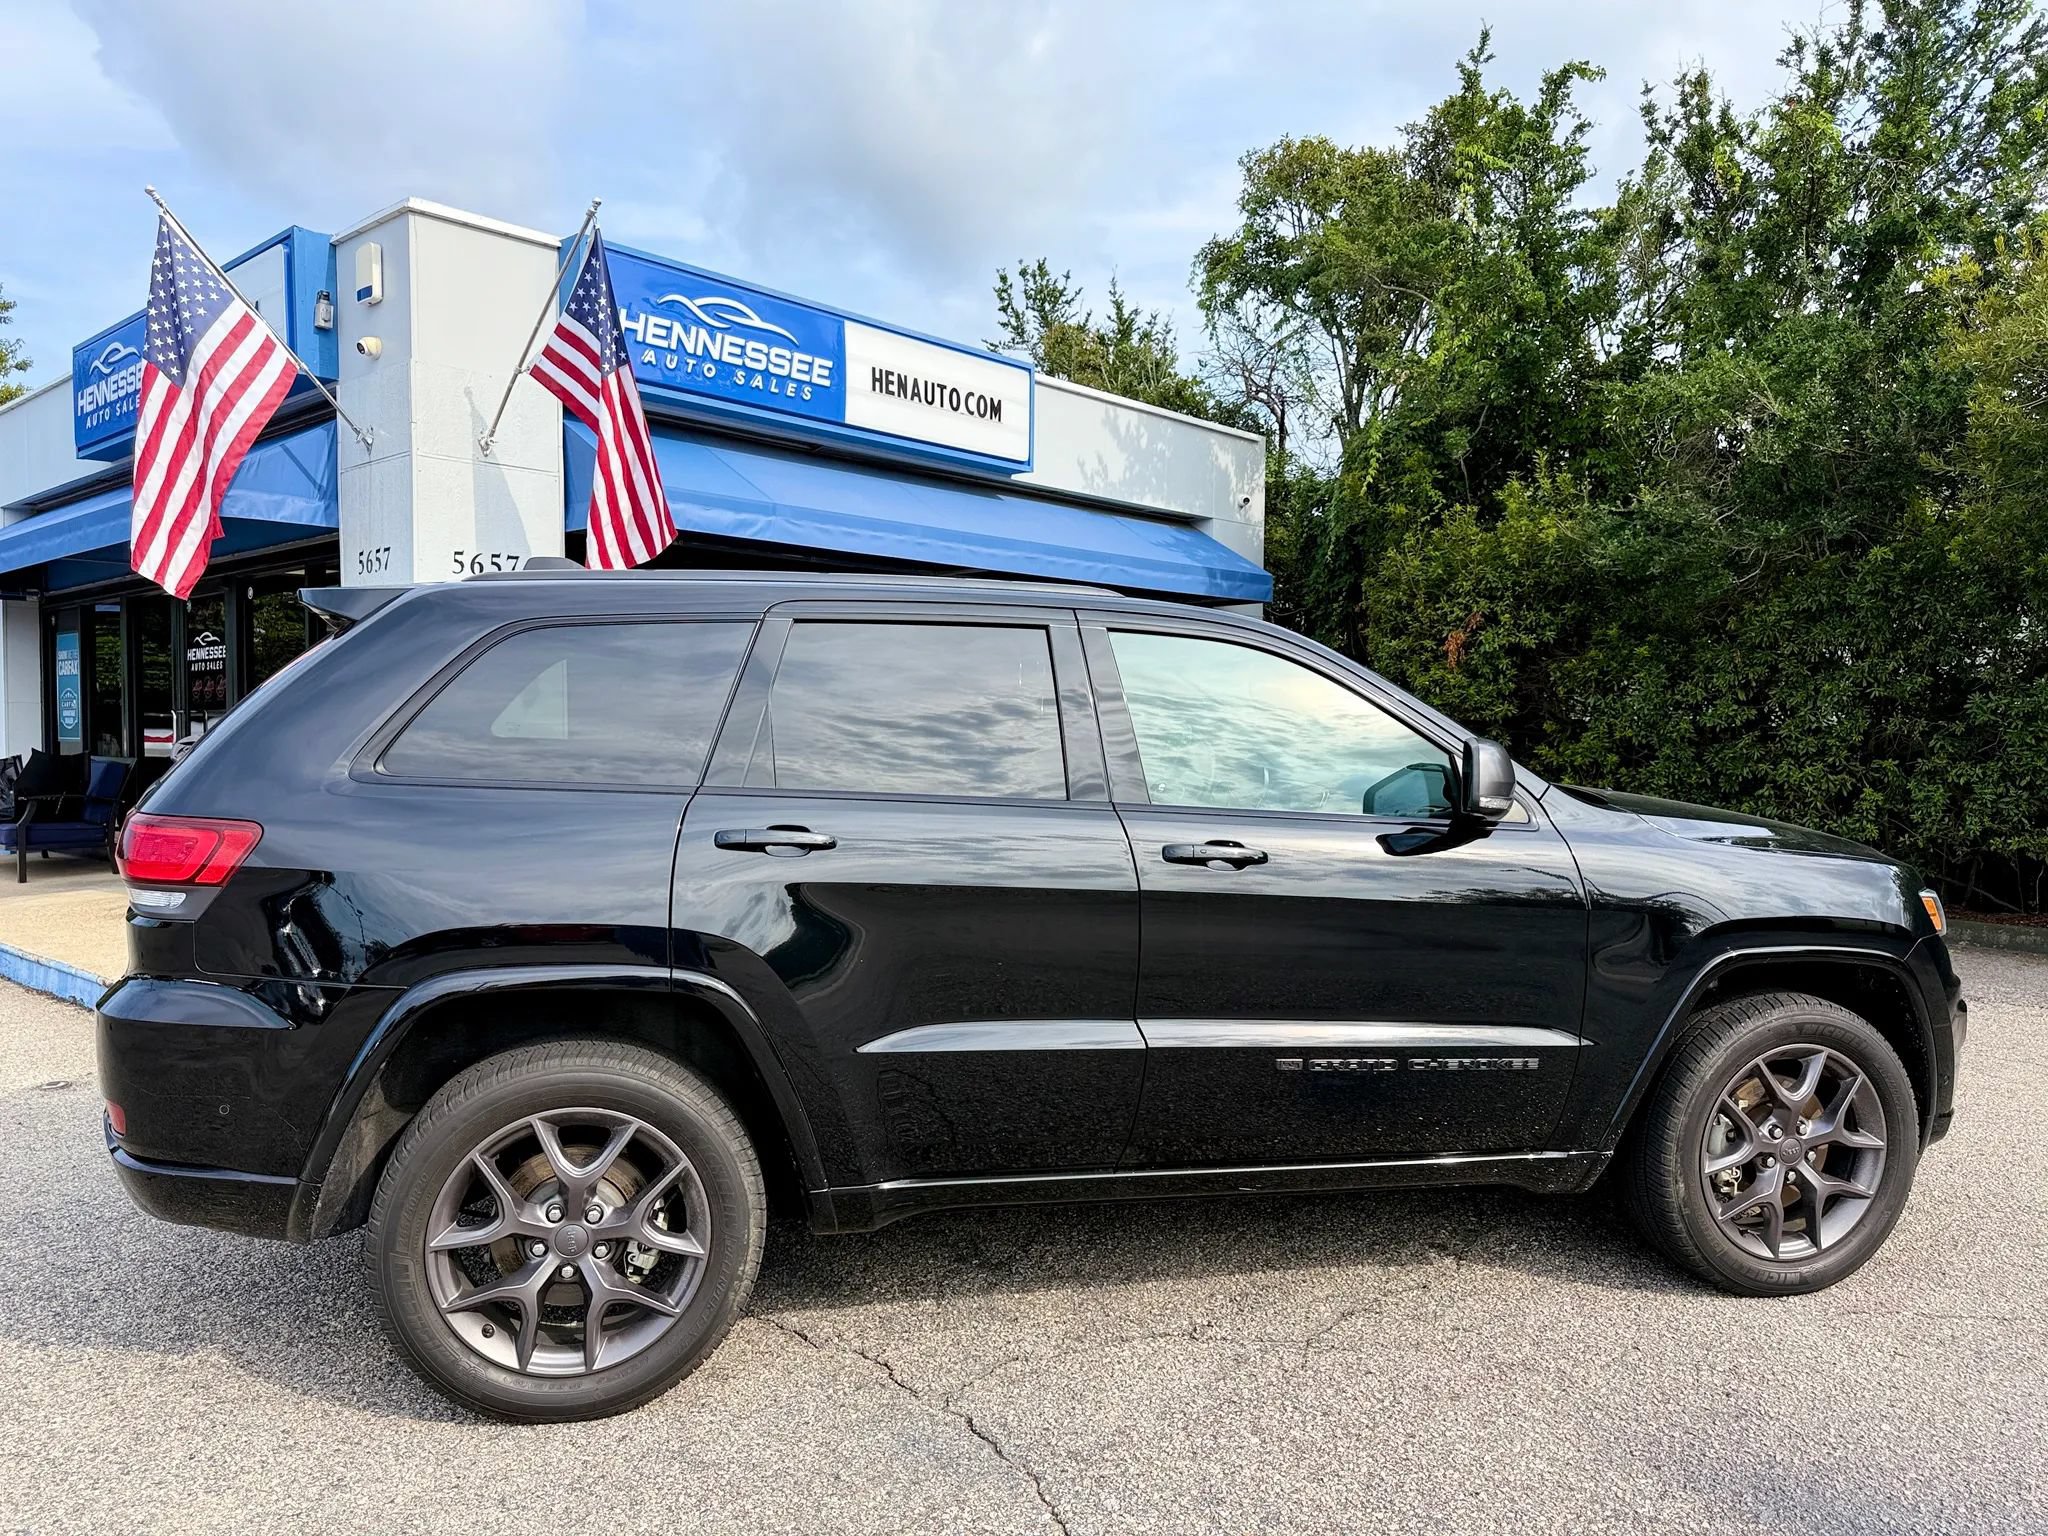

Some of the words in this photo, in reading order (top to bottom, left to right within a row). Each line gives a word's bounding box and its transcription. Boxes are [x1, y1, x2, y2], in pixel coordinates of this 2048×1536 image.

[619, 308, 834, 388] HENNESSEE
[77, 362, 142, 417] HENNESSE
[641, 349, 717, 378] AUTO
[734, 369, 813, 401] SALES
[86, 406, 110, 429] AUTO
[116, 393, 141, 416] SALE
[358, 546, 391, 575] 5657
[452, 549, 520, 575] 5657
[187, 645, 227, 661] HENNESSEE
[191, 661, 206, 671] AUTO
[206, 660, 223, 670] SALES
